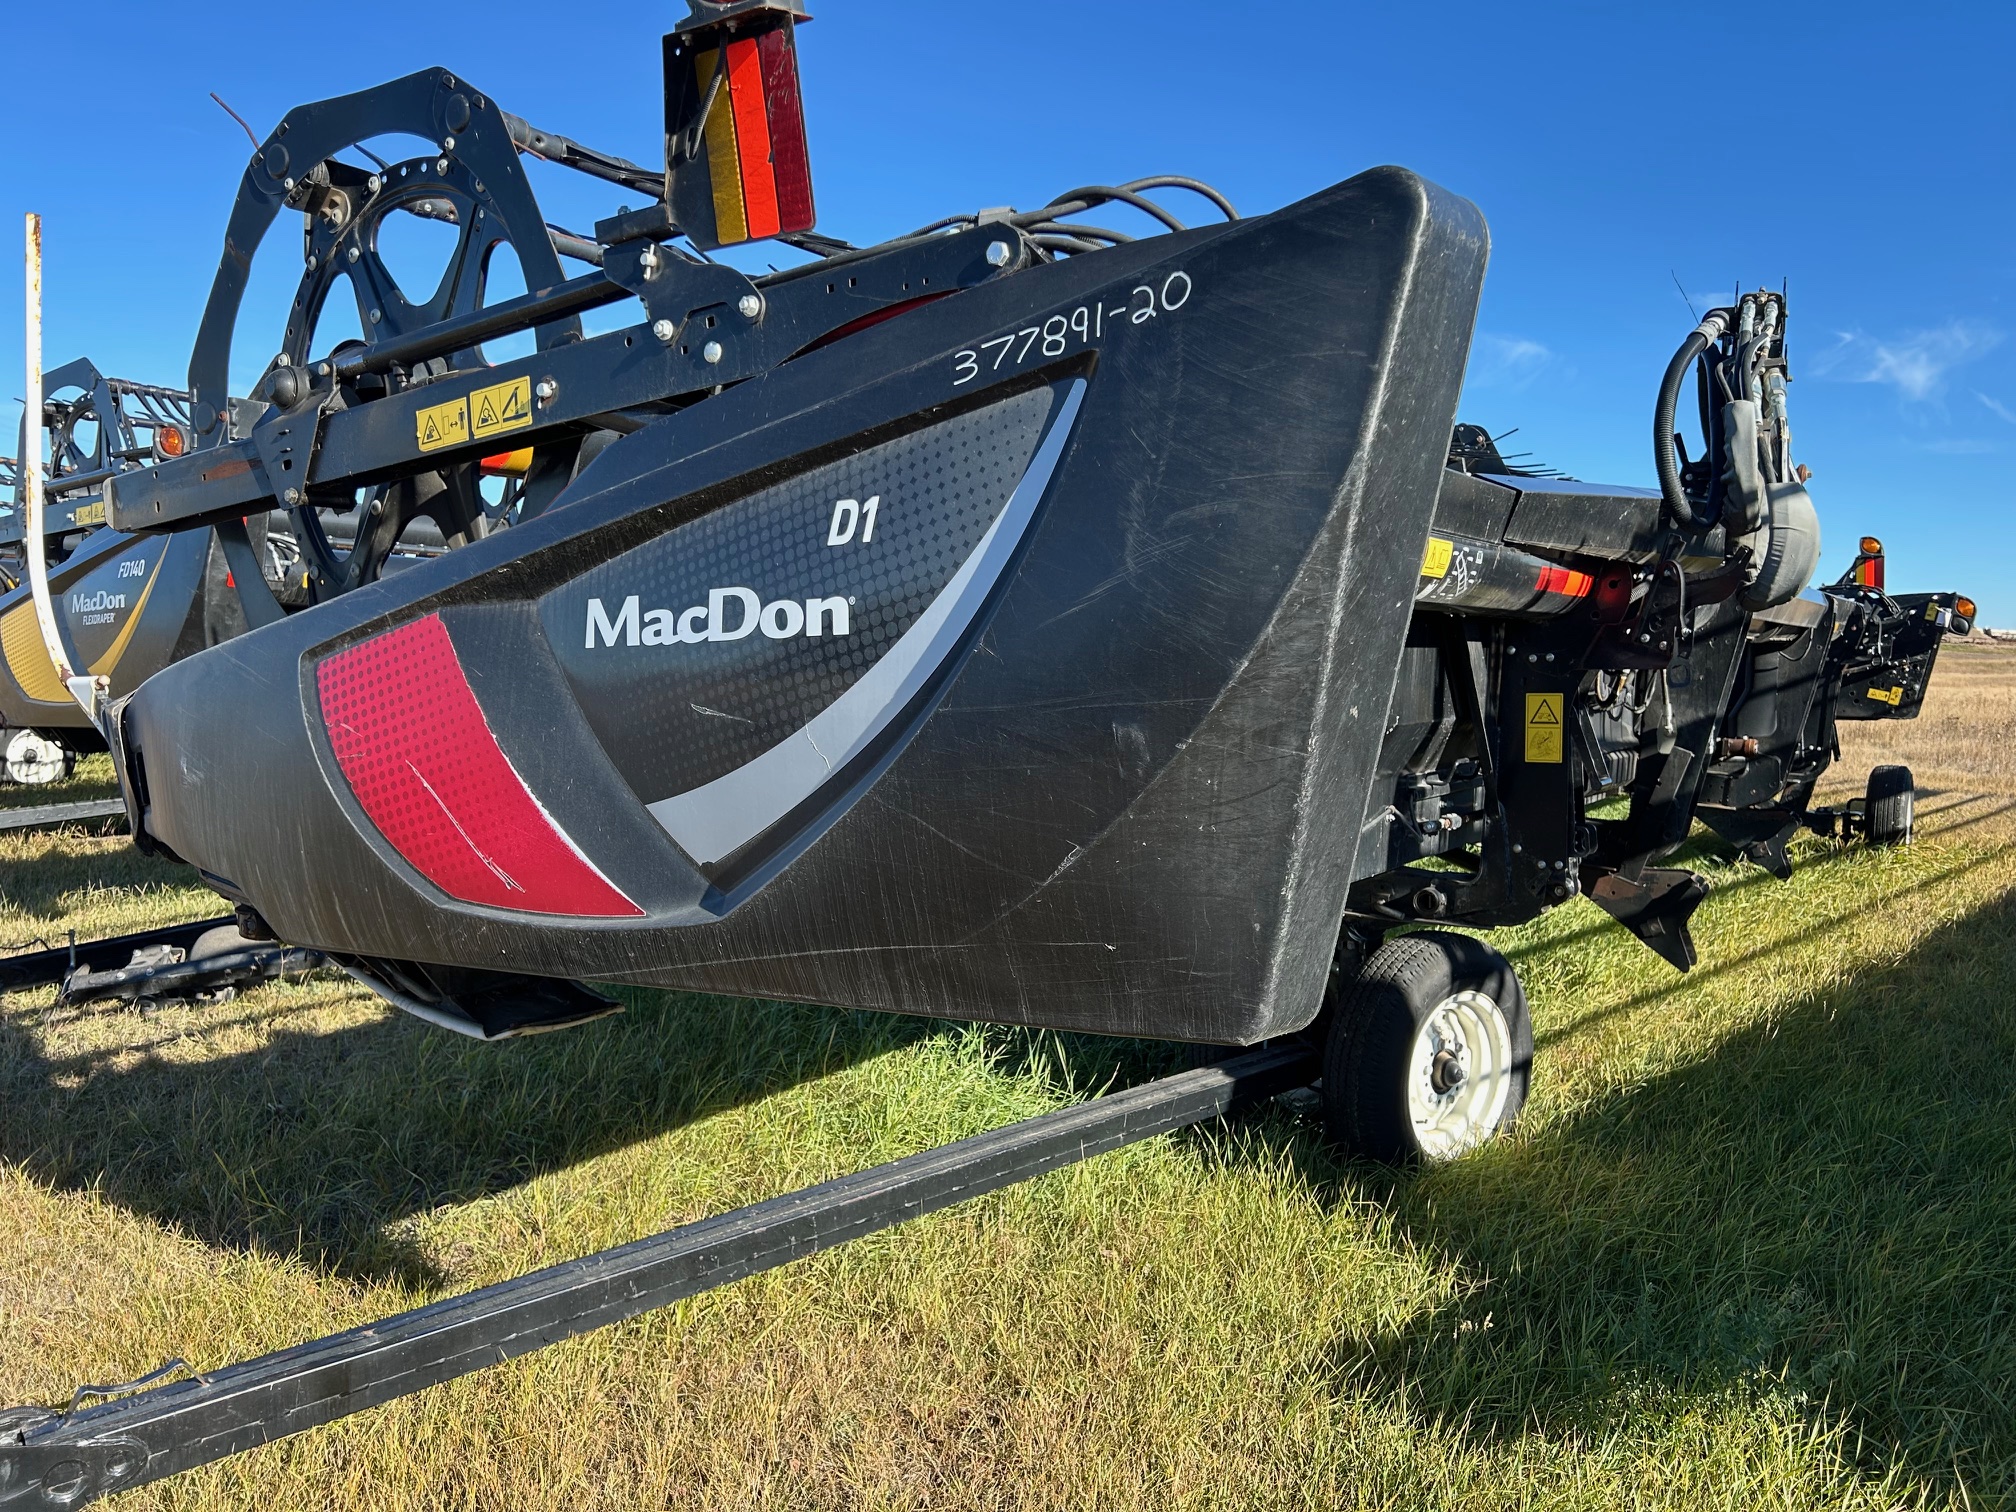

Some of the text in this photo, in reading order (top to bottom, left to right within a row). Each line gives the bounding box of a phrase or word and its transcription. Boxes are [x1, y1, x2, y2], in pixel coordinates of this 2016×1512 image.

[953, 271, 1192, 386] 377891-20
[827, 495, 880, 546] D1
[117, 559, 145, 578] FD140
[72, 590, 125, 613] MacDon
[82, 613, 115, 625] FLEXDRAPER
[584, 586, 850, 649] MacDon
